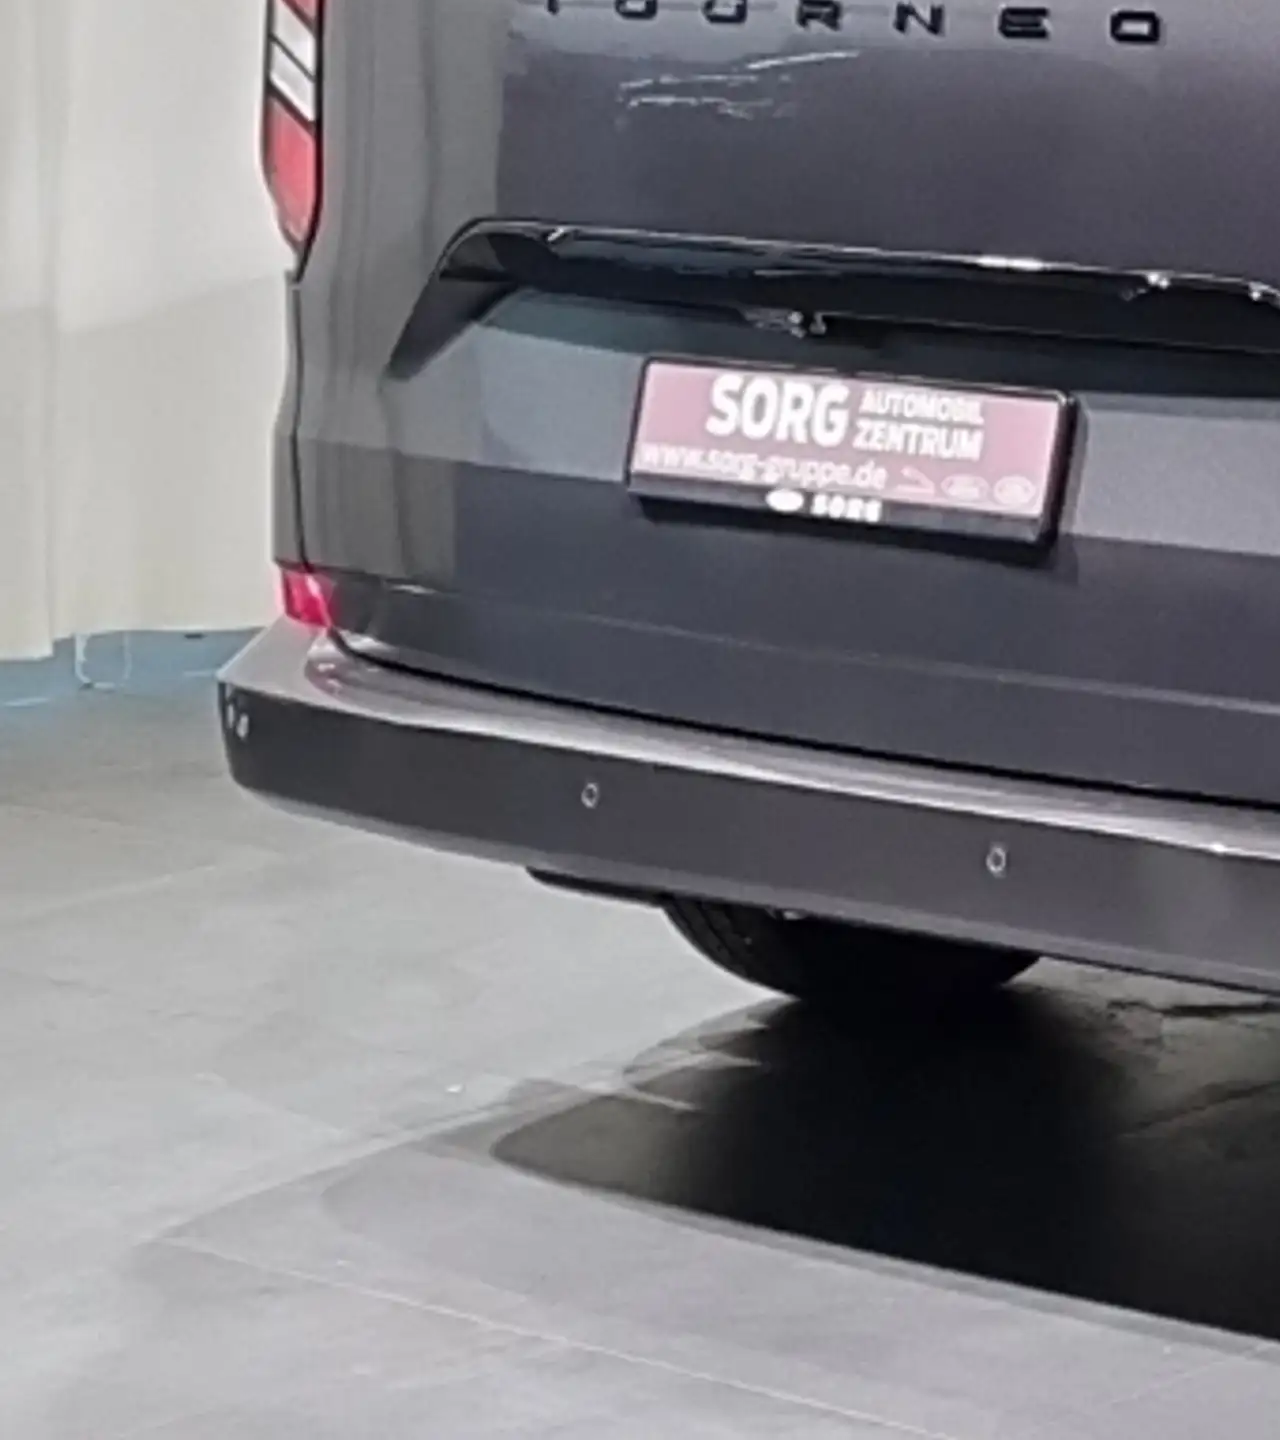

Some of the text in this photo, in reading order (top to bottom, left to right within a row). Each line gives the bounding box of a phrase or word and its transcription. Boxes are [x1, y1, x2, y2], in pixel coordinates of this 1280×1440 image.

[706, 374, 850, 447] SORG
[859, 389, 984, 424] AUTOMOBIL
[852, 417, 983, 461] ZENTRUM
[639, 443, 888, 491] www.sorg-gruppe.de
